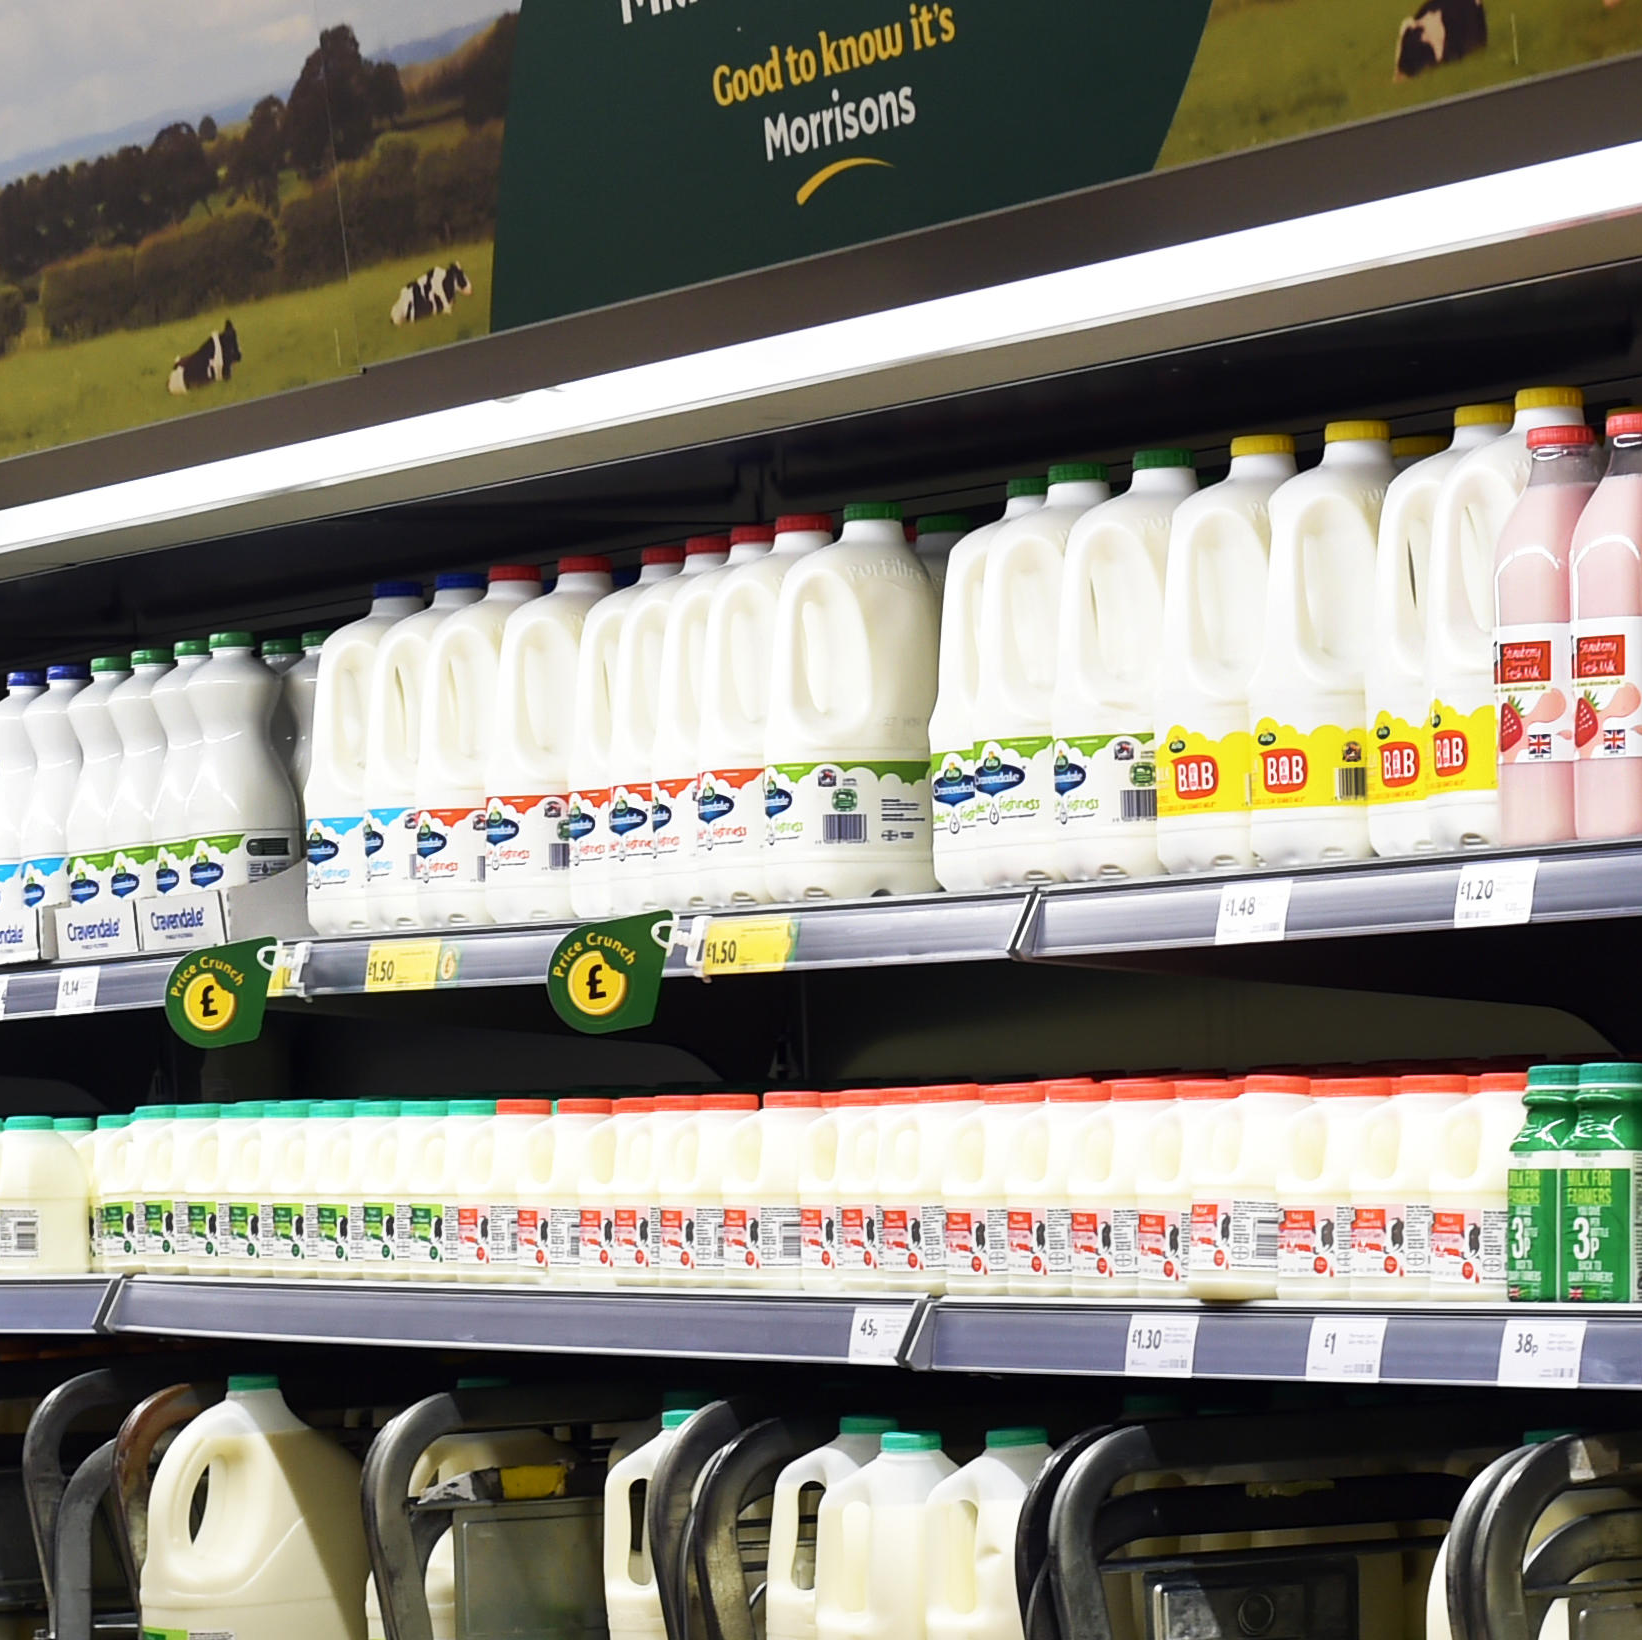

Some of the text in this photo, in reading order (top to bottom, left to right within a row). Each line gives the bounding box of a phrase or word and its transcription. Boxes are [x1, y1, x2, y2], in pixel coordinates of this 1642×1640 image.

[712, 2, 956, 107] Good to know it's
[763, 87, 917, 162] Morrisons
[1460, 878, 1495, 901] £1.20
[150, 906, 205, 933] Cravendale
[1224, 895, 1256, 918] £1.48
[67, 916, 120, 944] Cravendale
[552, 931, 637, 979] Price Crunch
[707, 939, 737, 965] £1.50
[170, 955, 245, 997] Price Crunch
[368, 960, 394, 983] £1.50
[586, 963, 607, 1001] £
[200, 984, 218, 1018] £
[1567, 1188, 1612, 1205] FARMERS
[860, 1317, 878, 1338] 45p
[1132, 1328, 1162, 1351] £1.30
[1324, 1329, 1336, 1354] £1
[1514, 1333, 1539, 1357] 38p
